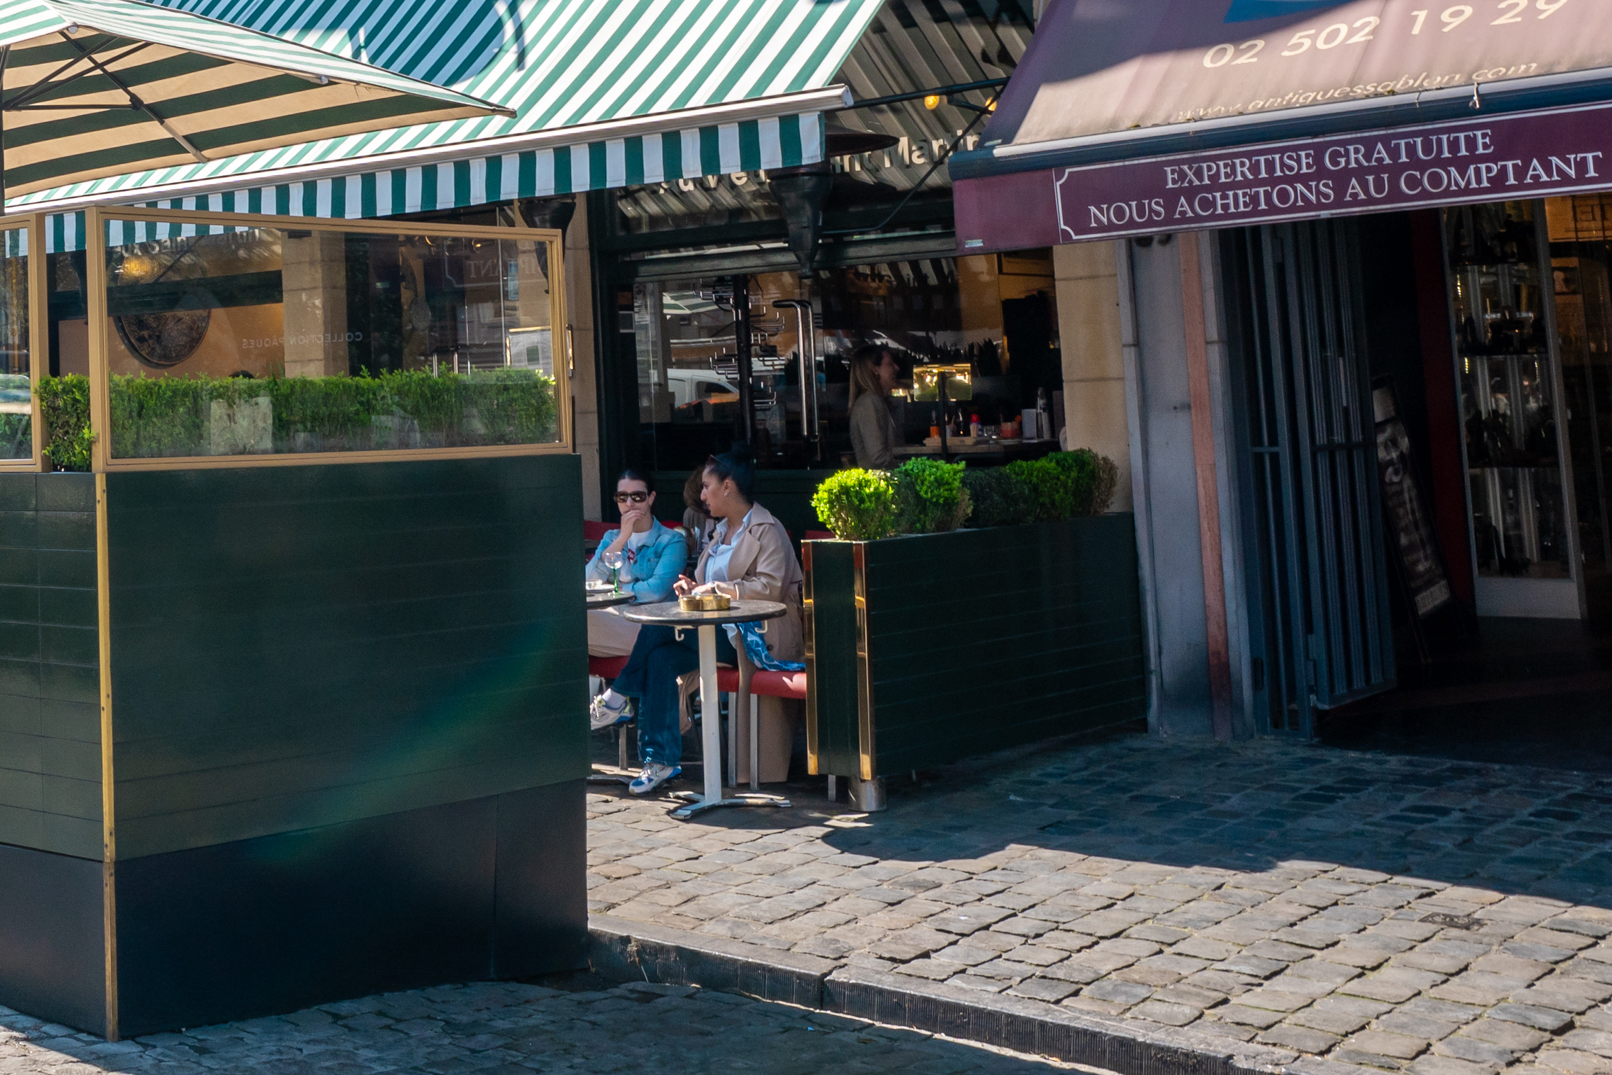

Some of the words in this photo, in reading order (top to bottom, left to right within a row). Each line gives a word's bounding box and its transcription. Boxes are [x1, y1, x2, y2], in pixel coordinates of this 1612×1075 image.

[1202, 39, 1266, 69] 02
[1280, 16, 1381, 57] 502
[1410, 4, 1474, 36] 19
[1088, 198, 1166, 227] NOUS
[1173, 180, 1335, 219] ACHETONS
[1345, 173, 1390, 202] AU
[1399, 151, 1603, 196] COMPTANT
[1163, 149, 1317, 190] EXPERTISE
[1324, 129, 1495, 171] GRATUITE
